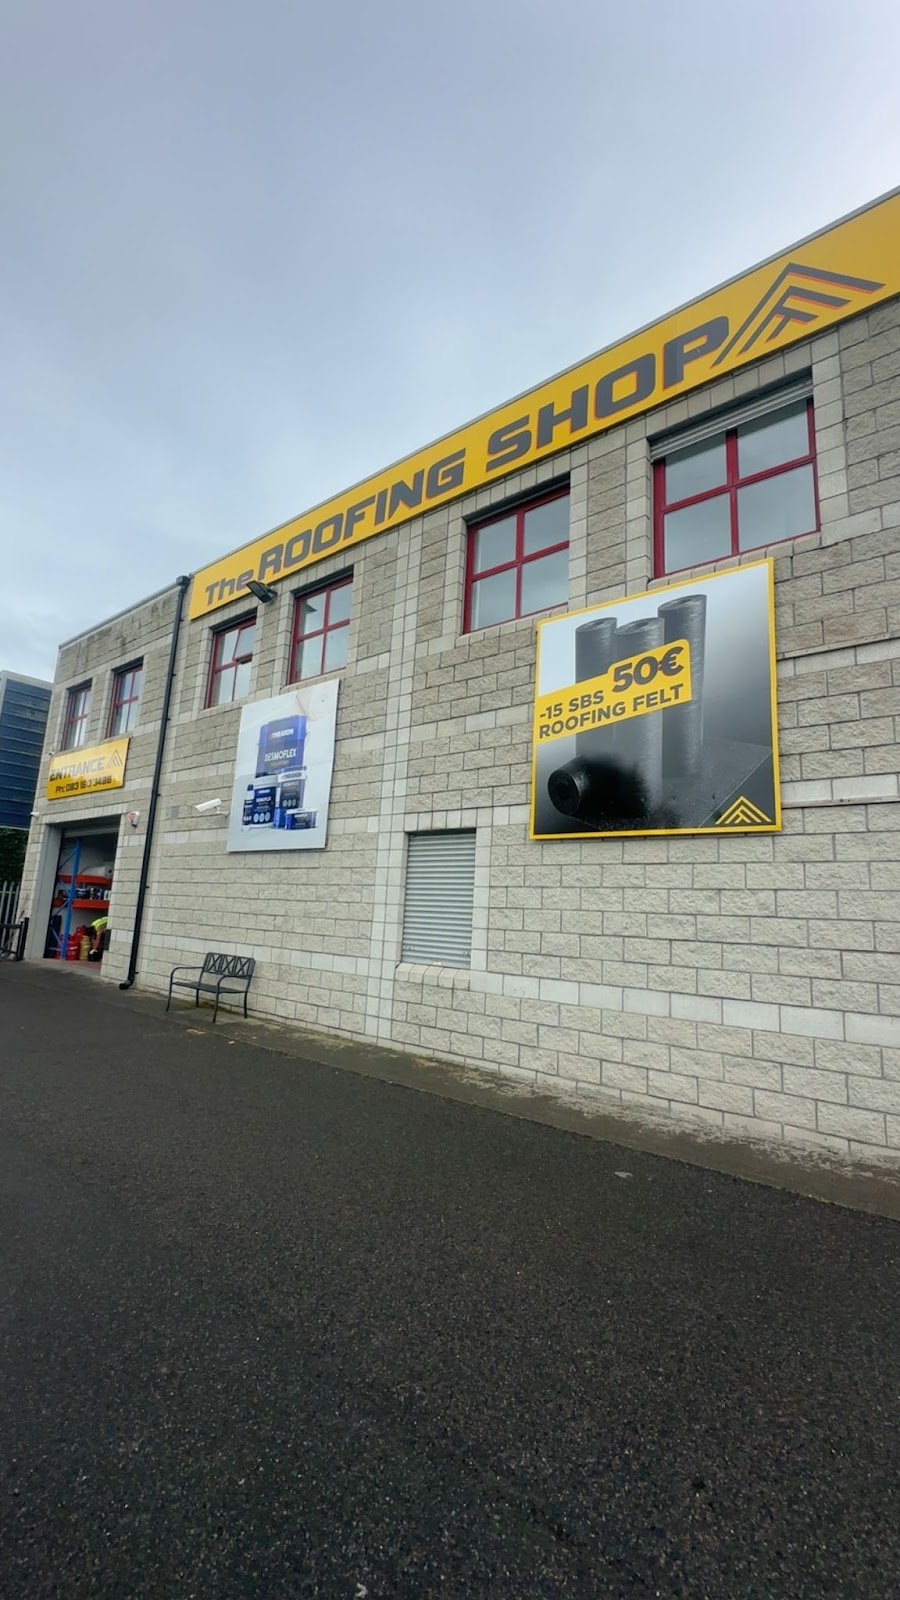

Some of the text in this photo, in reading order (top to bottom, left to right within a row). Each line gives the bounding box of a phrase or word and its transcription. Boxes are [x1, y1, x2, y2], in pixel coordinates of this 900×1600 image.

[205, 315, 729, 606] The ROOFING SHOP
[539, 646, 685, 720] -15 SBS 50€
[539, 683, 684, 739] ROOFING FELT
[49, 756, 106, 782] ENTRANCE
[264, 748, 297, 762] DESMOFLEX
